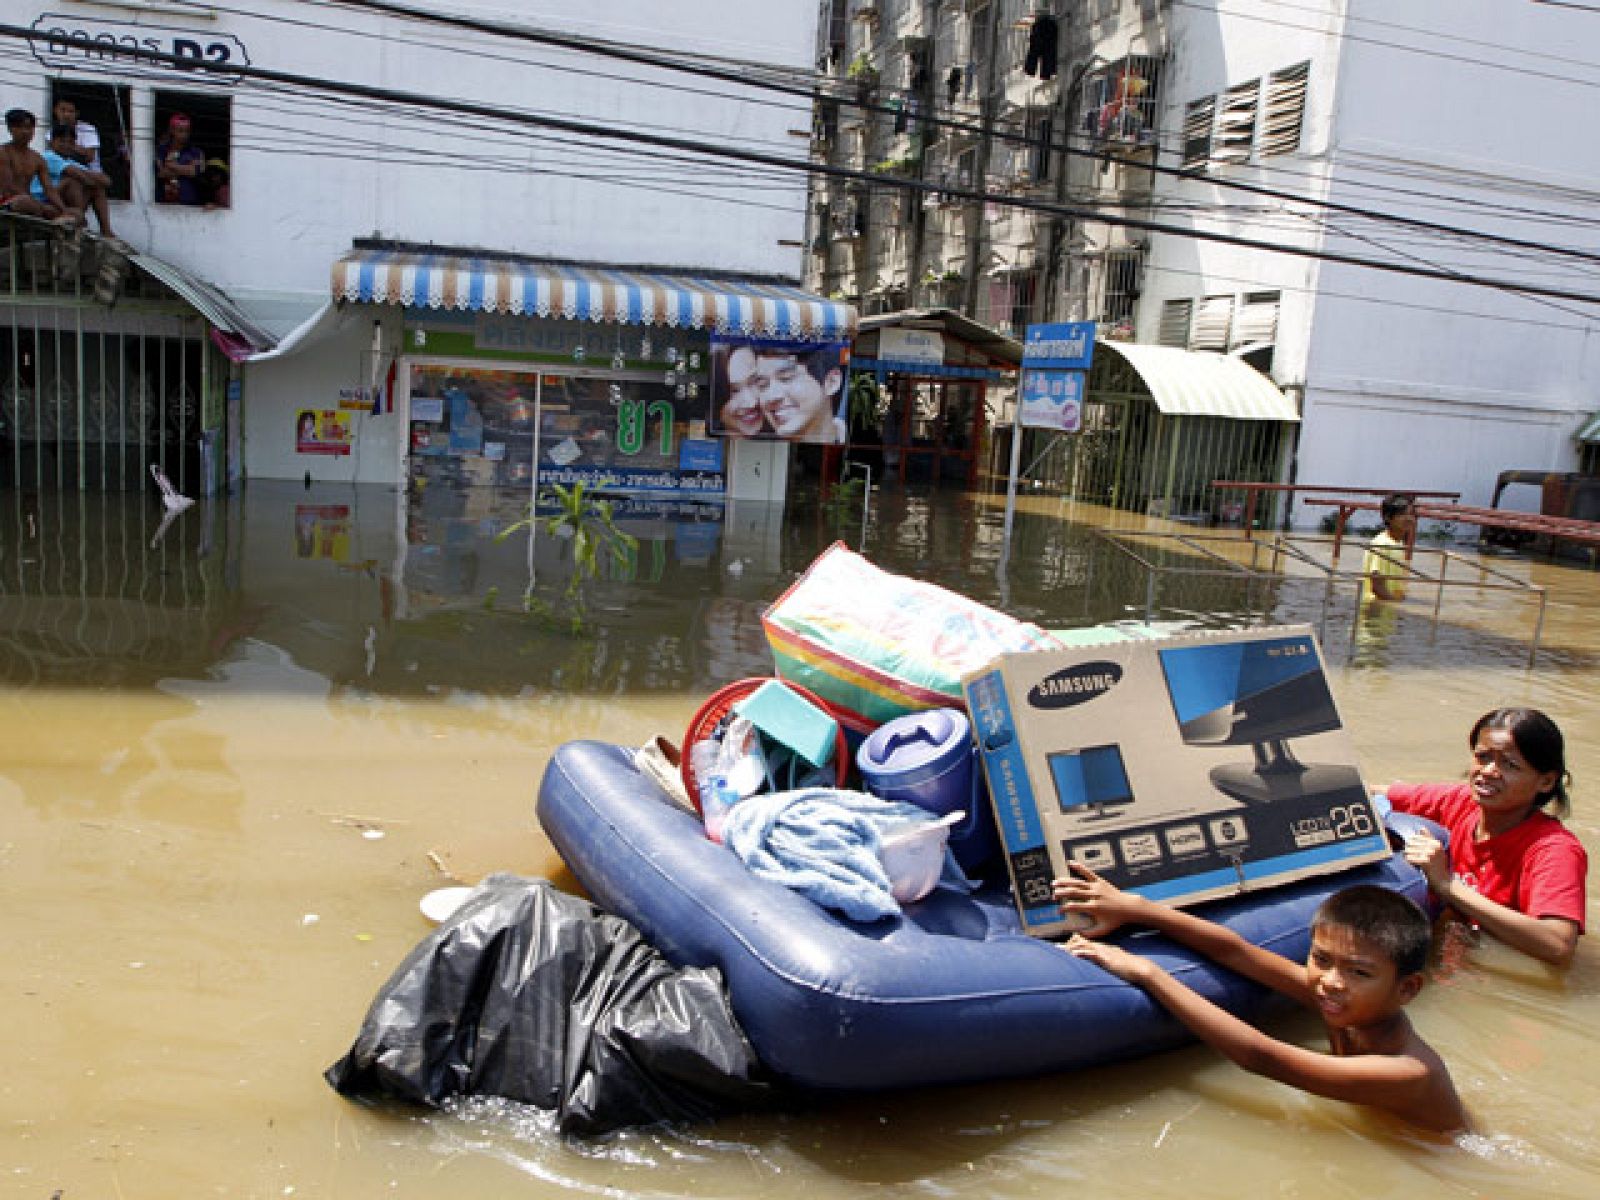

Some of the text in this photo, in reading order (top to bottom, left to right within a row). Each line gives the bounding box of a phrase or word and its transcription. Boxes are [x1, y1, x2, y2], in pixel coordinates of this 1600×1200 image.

[174, 38, 231, 71] D2
[618, 400, 674, 455] ยา
[1040, 673, 1115, 696] SAMSUNG
[1330, 802, 1373, 839] 26
